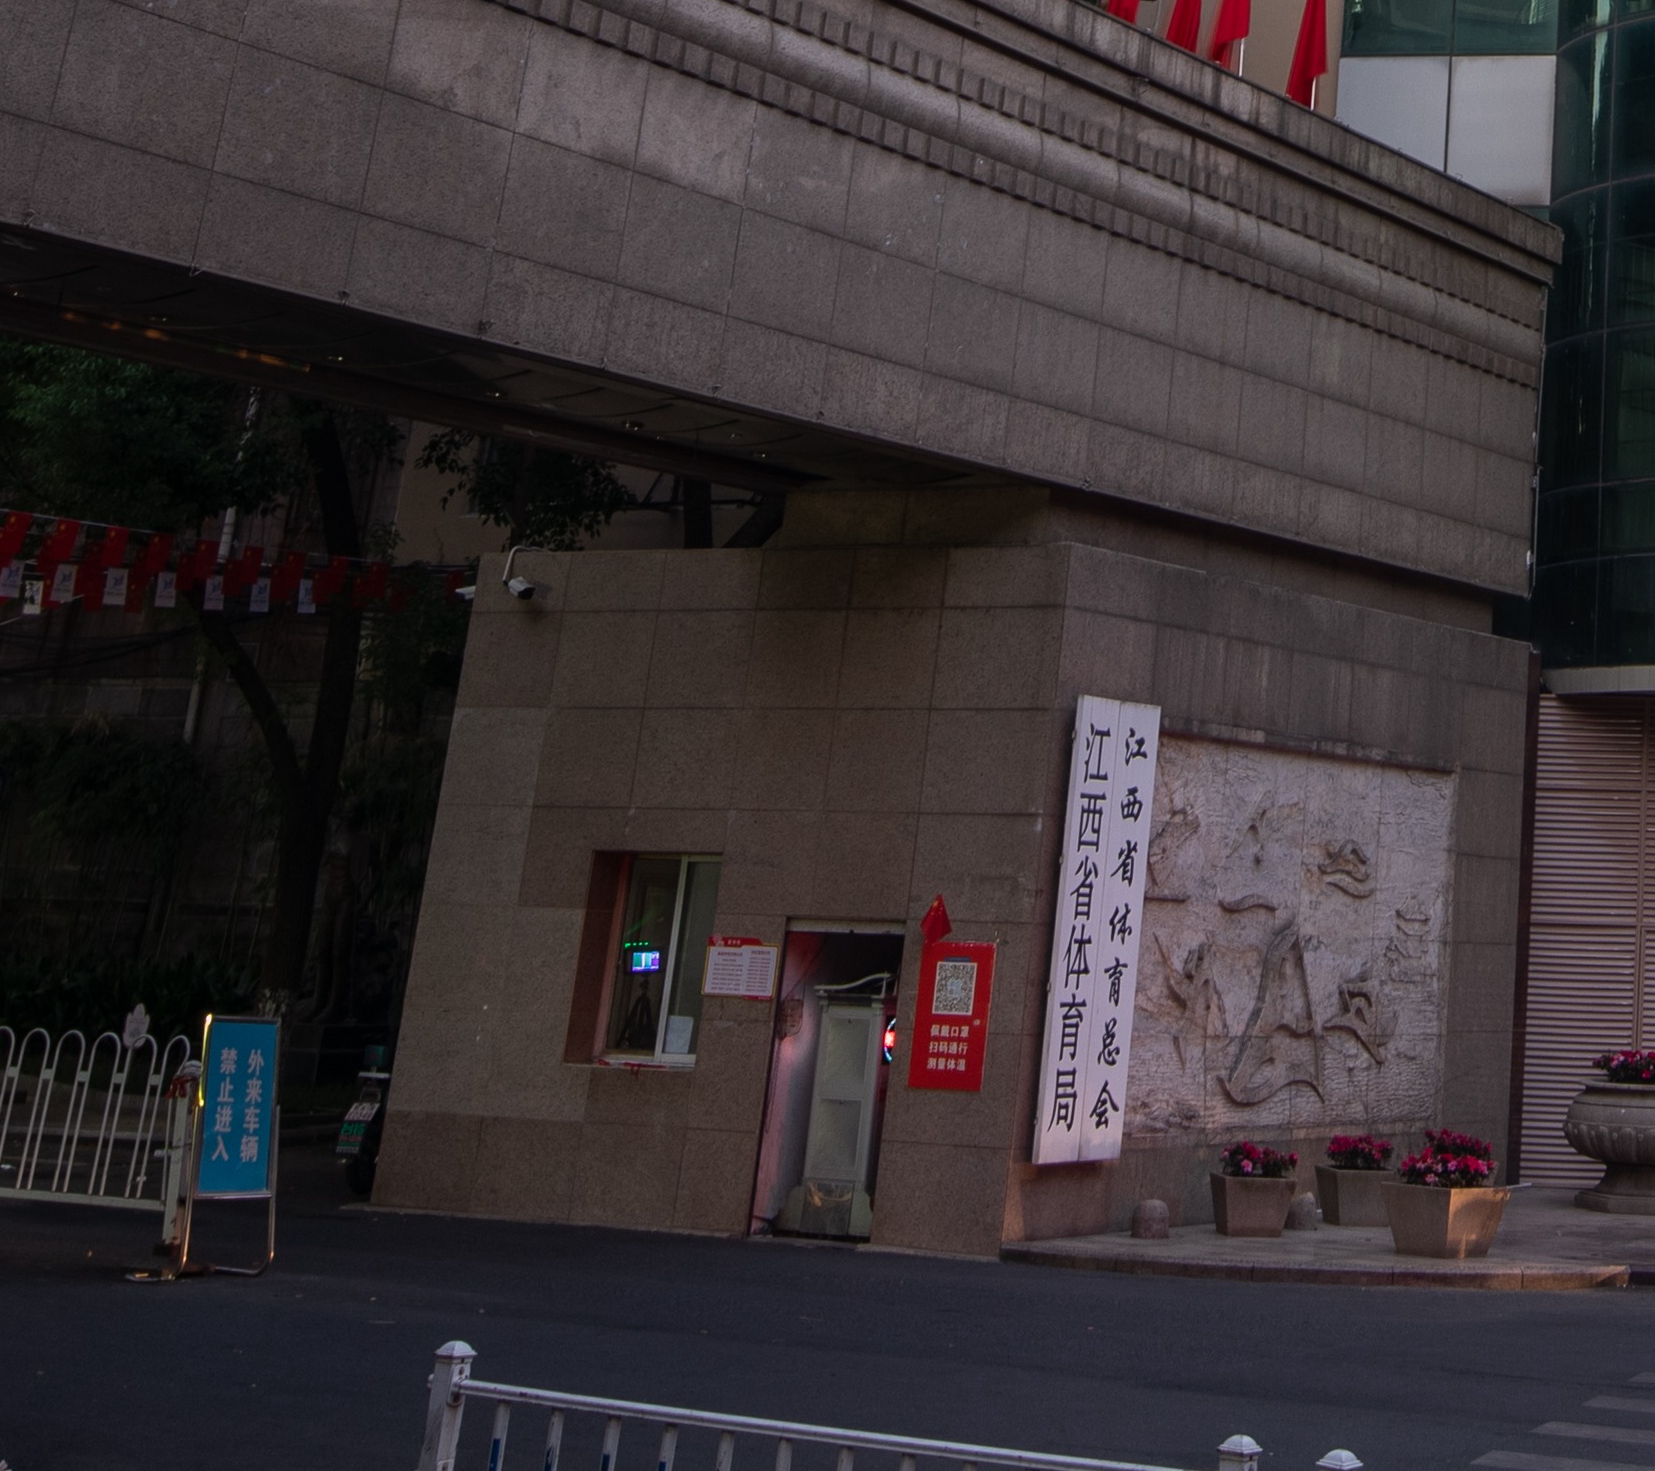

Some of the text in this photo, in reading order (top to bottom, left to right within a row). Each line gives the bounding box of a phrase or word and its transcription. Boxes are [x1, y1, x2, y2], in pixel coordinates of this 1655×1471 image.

[1047, 722, 1111, 1133] 江西省体育局
[1089, 727, 1148, 1132] 江西省体育总会
[211, 1047, 239, 1162] 禁止进入
[239, 1048, 265, 1163] 外来车辆
[928, 1041, 969, 1056] 扫码通行
